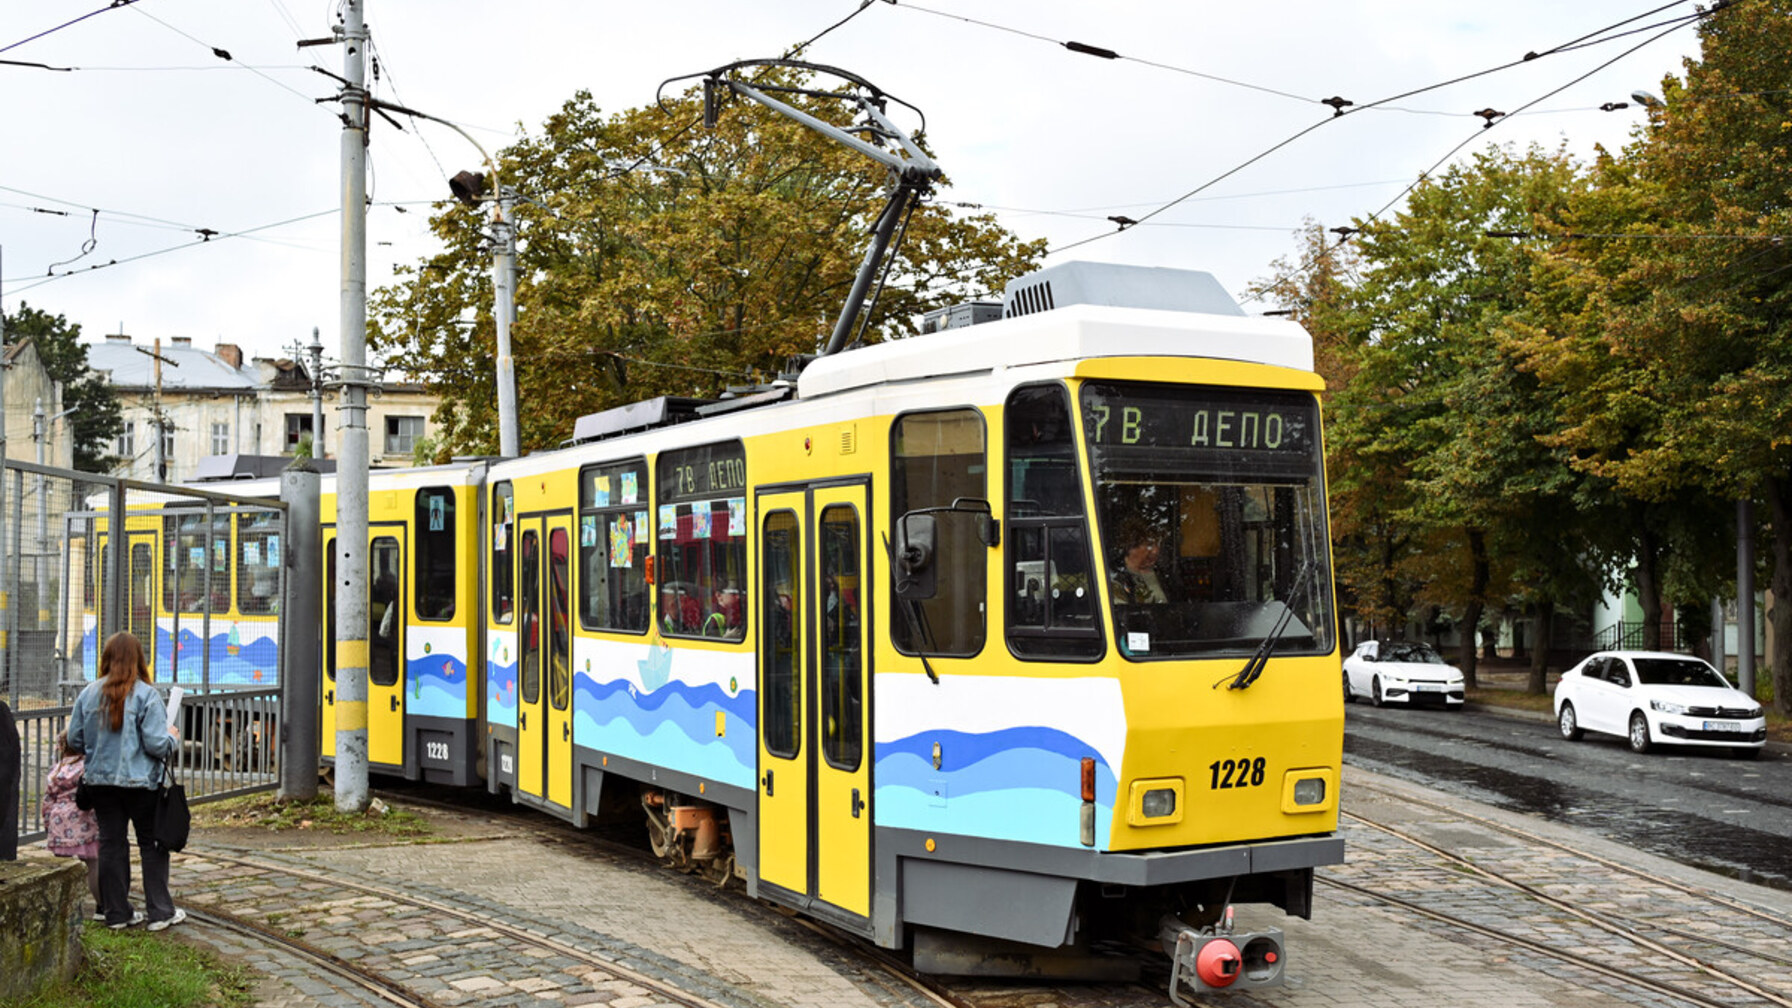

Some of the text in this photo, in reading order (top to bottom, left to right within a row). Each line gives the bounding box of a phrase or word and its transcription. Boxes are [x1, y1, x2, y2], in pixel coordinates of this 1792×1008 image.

[1191, 409, 1284, 449] ДЕПО
[708, 458, 745, 490] ДЕПО
[426, 742, 449, 760] 1228
[1209, 756, 1267, 790] 1228
